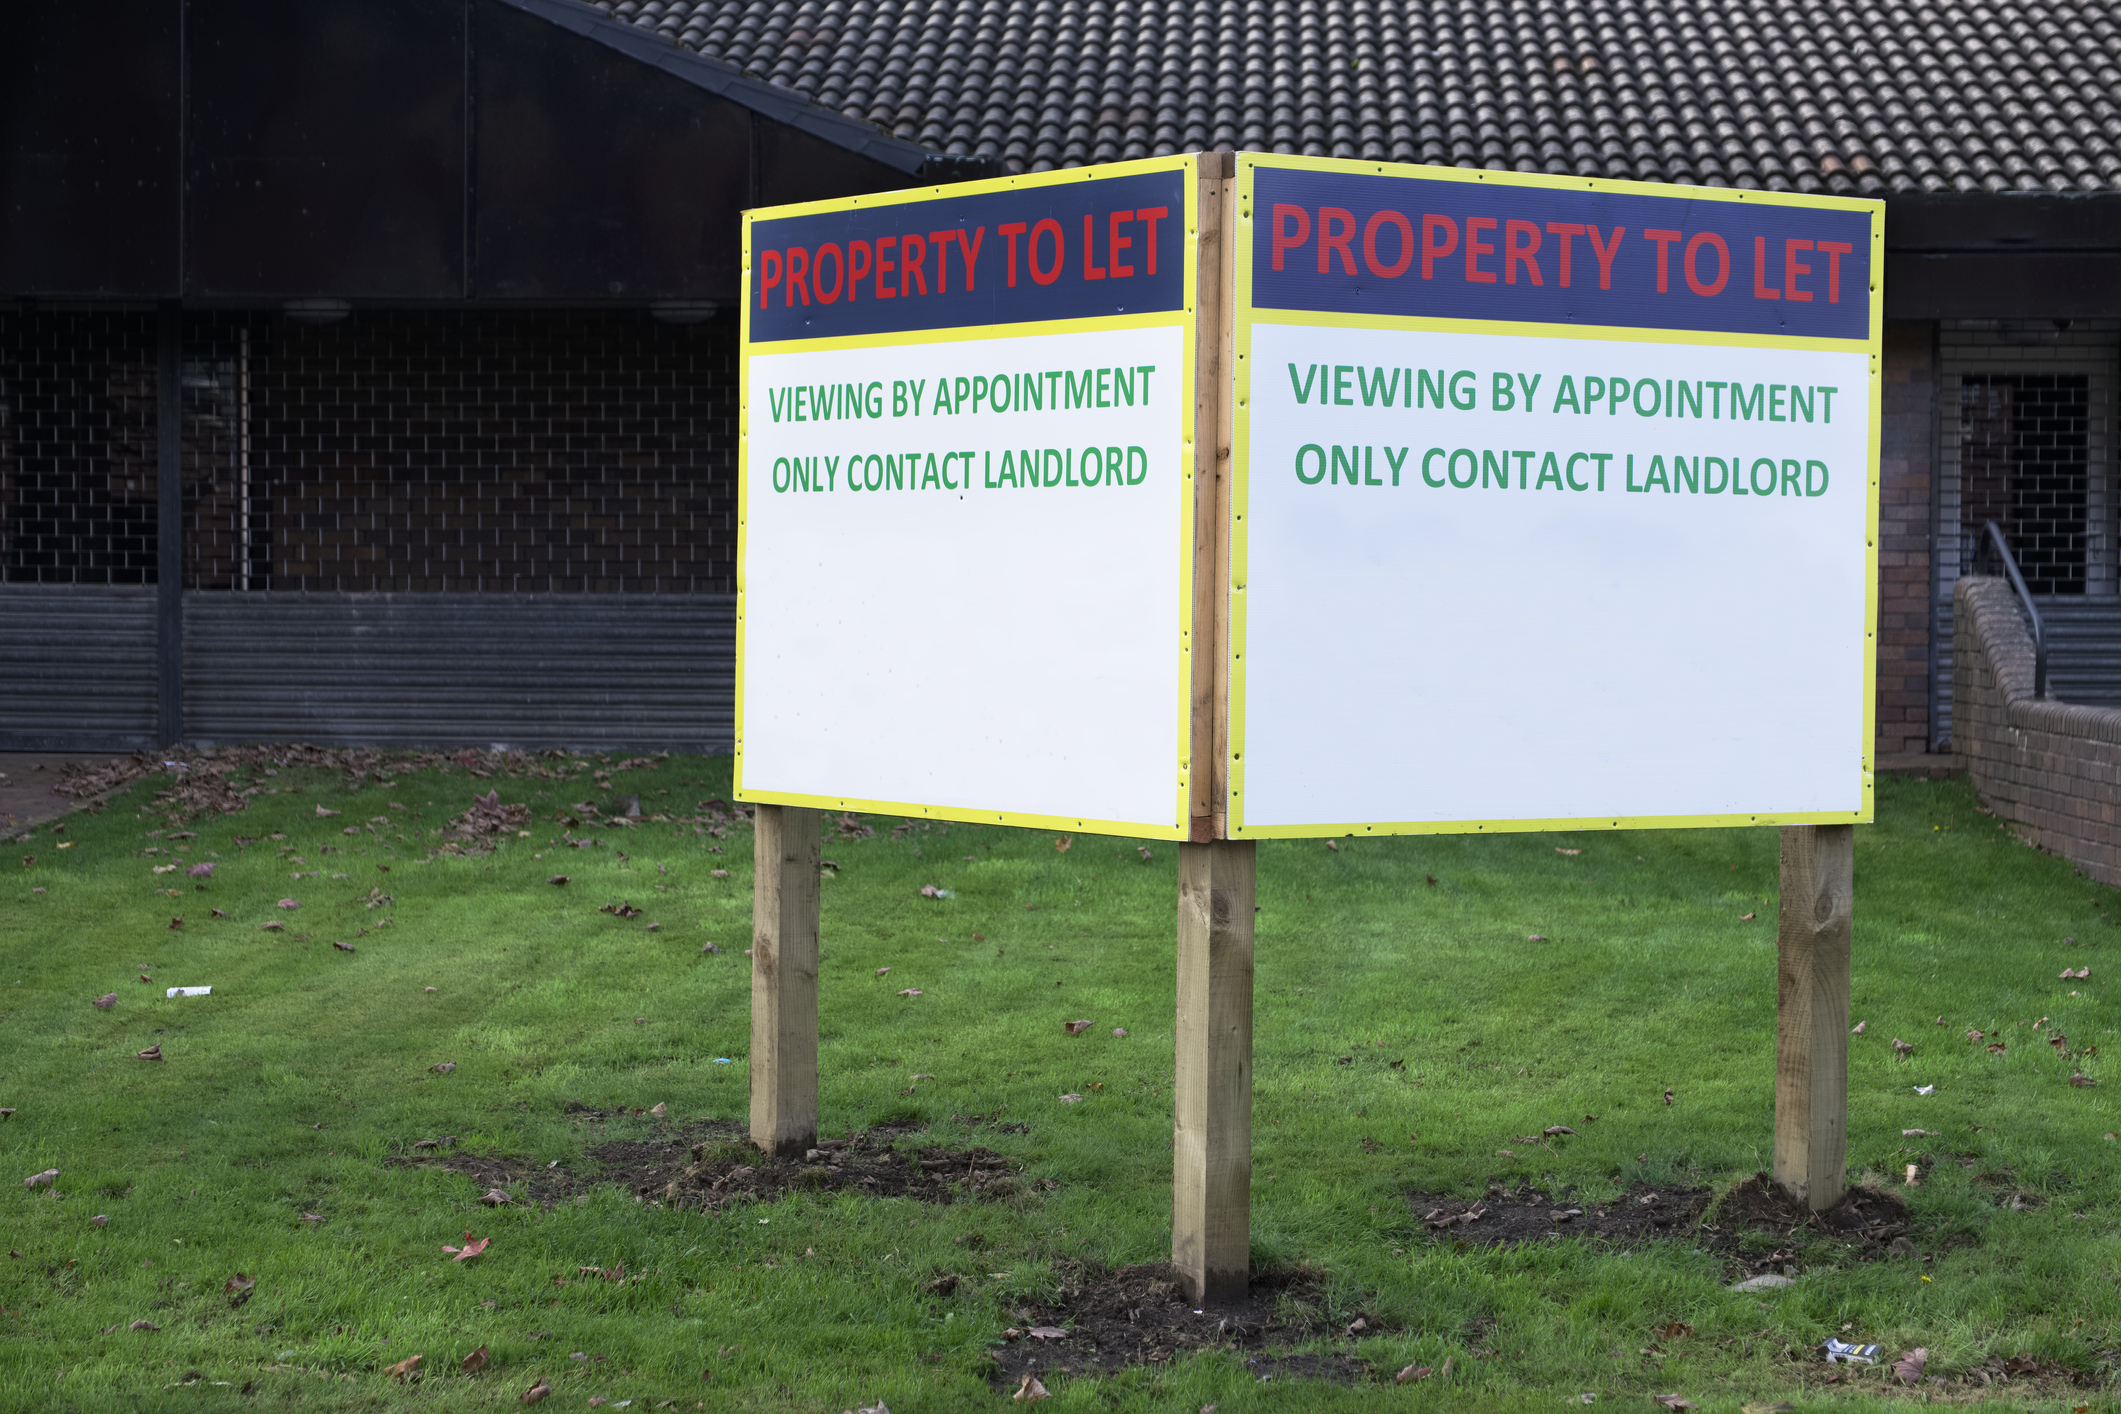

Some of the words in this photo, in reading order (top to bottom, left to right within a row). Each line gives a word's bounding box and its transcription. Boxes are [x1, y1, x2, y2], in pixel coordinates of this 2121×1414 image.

[760, 226, 986, 310] PROPERTY
[997, 218, 1065, 288] TO
[1083, 206, 1169, 281] LET
[1272, 203, 1626, 290] PROPERTY
[1643, 228, 1730, 297] TO
[1754, 236, 1853, 304] LET
[769, 380, 883, 423] VIEWING
[892, 379, 926, 418] BY
[933, 365, 1156, 416] APPOINTMENT
[1288, 363, 1476, 411] VIEWING
[1492, 372, 1541, 413] BY
[1552, 375, 1838, 424] APPOINTMENT
[772, 455, 840, 494] ONLY
[847, 450, 976, 492] CONTACT
[984, 445, 1148, 489] LANDLORD
[1295, 444, 1409, 487] ONLY
[1421, 447, 1613, 492] CONTACT
[1626, 454, 1829, 497] LANDLORD
